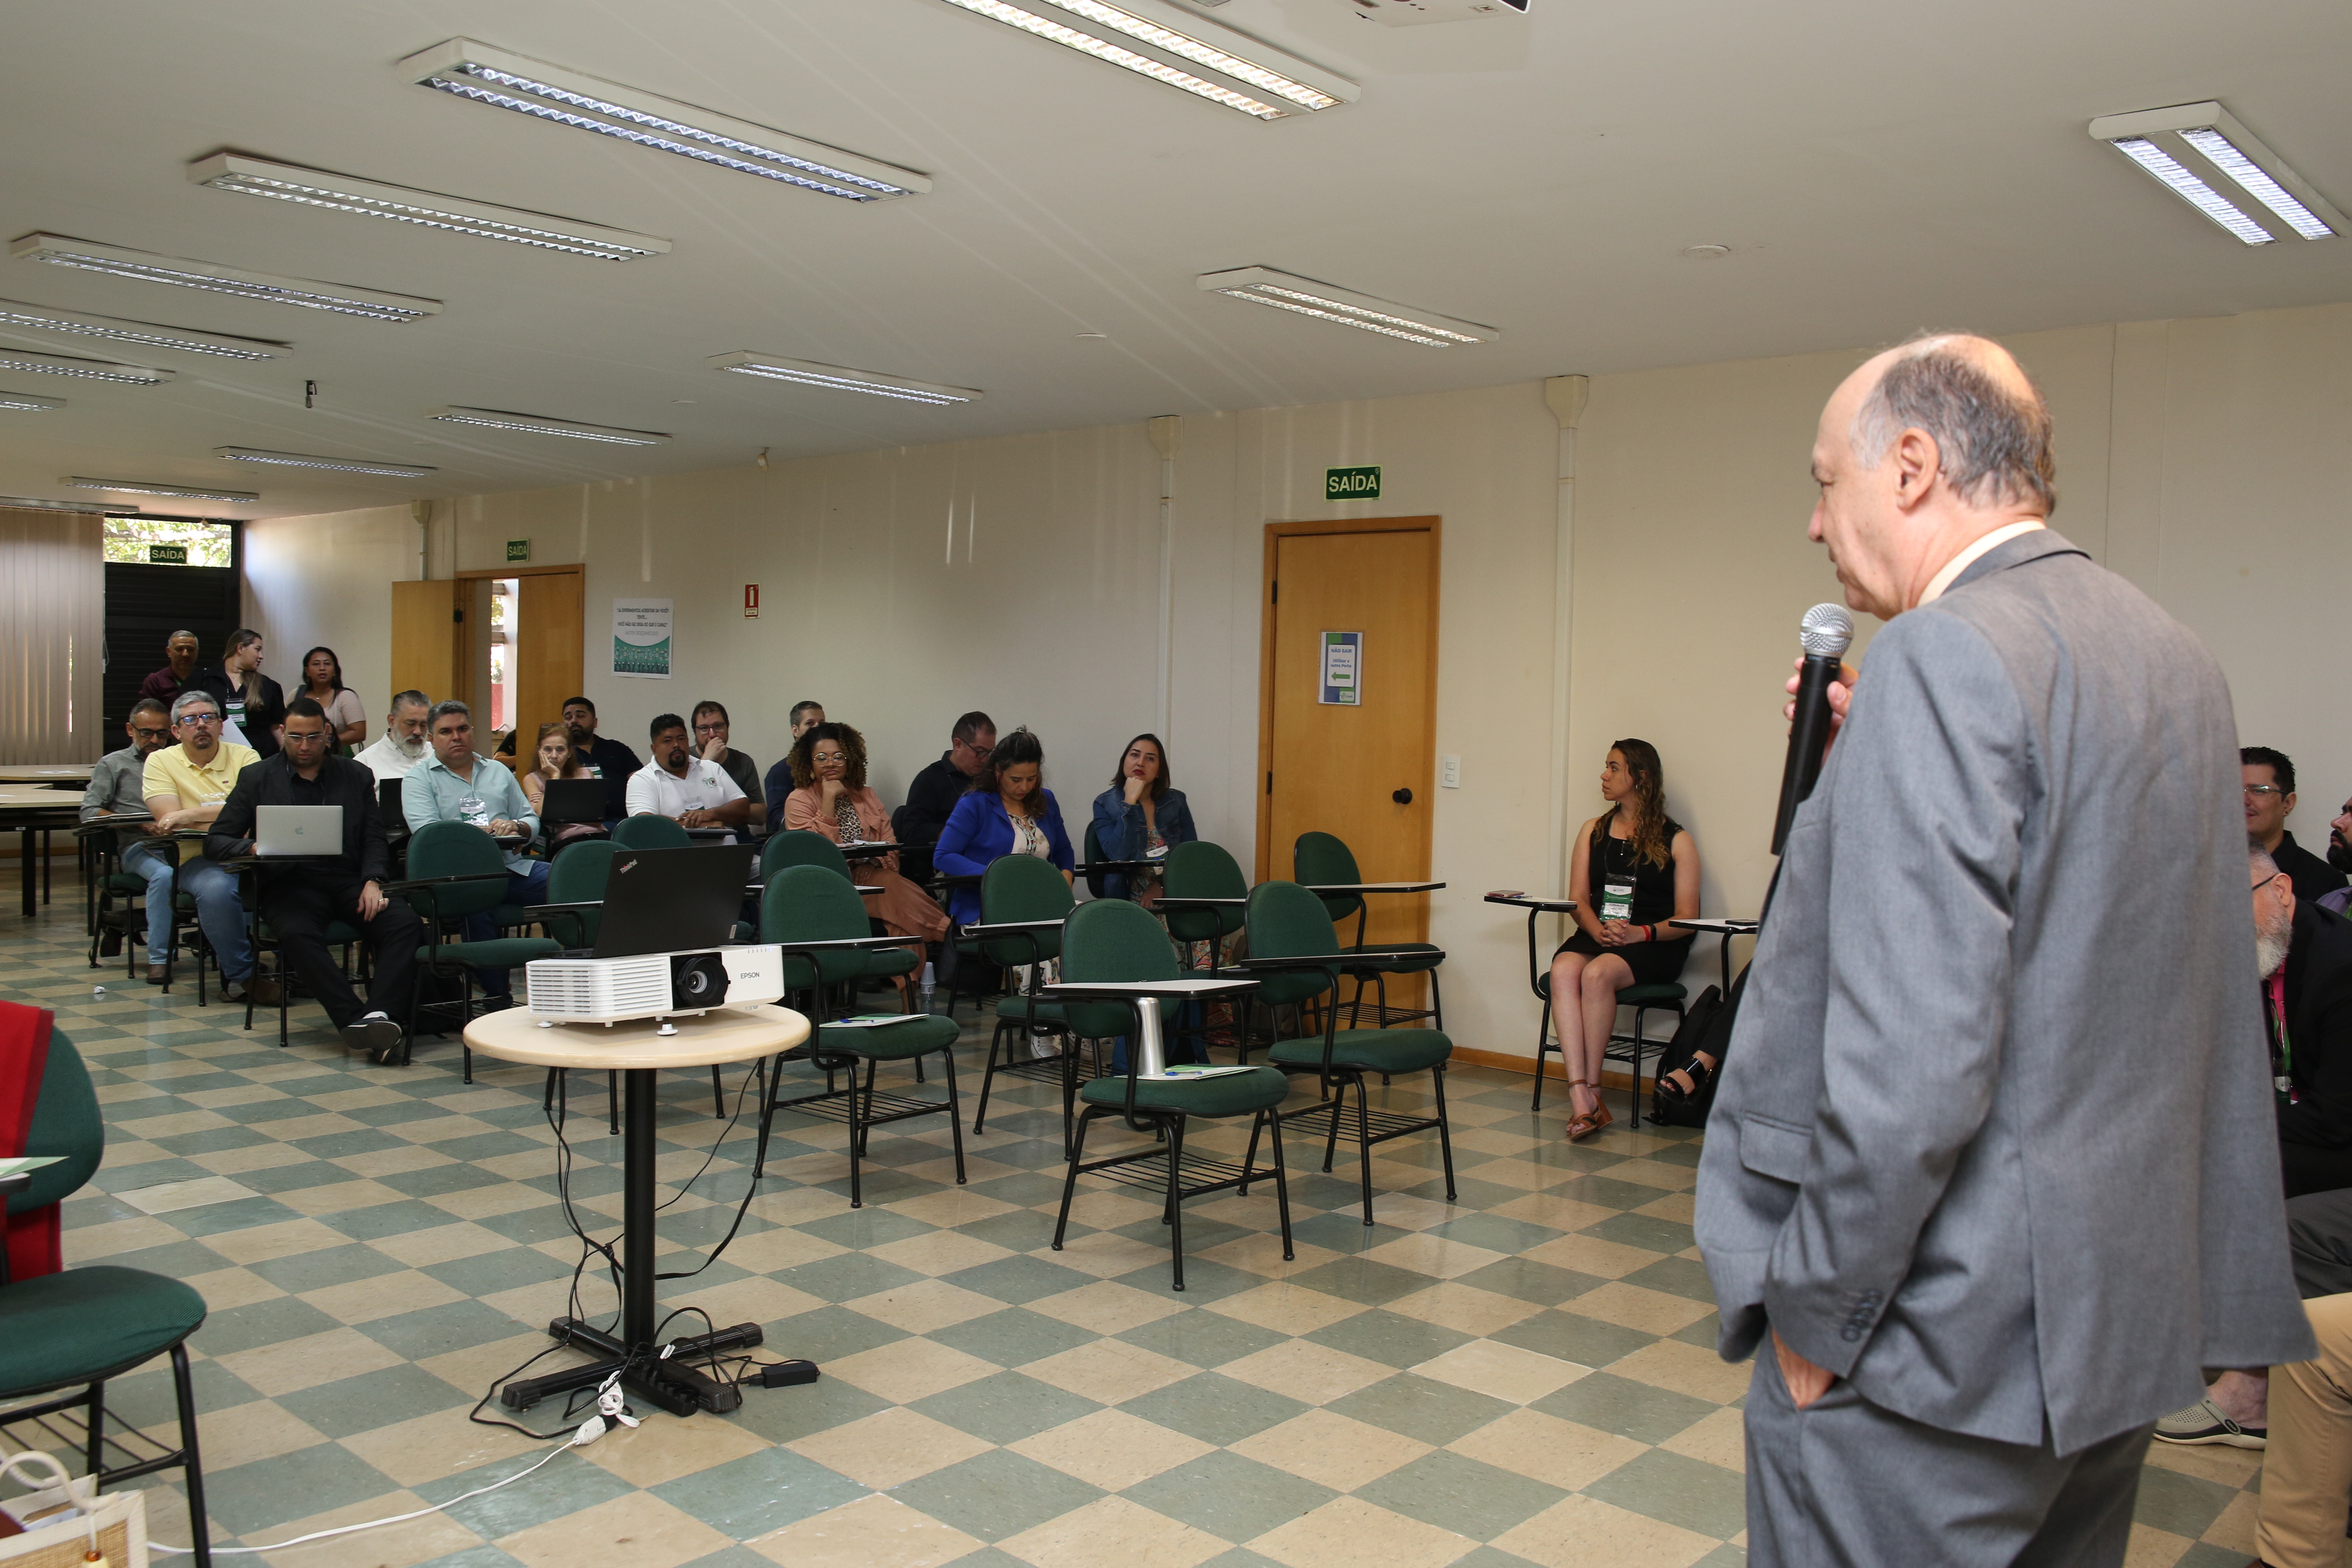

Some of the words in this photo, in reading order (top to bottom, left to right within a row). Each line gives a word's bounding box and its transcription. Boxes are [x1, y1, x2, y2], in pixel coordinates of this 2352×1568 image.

[1329, 471, 1378, 492] SAÍDA
[151, 548, 185, 560] SAÍDA
[508, 543, 527, 556] SAÍDA
[619, 859, 637, 873] ThinkPad
